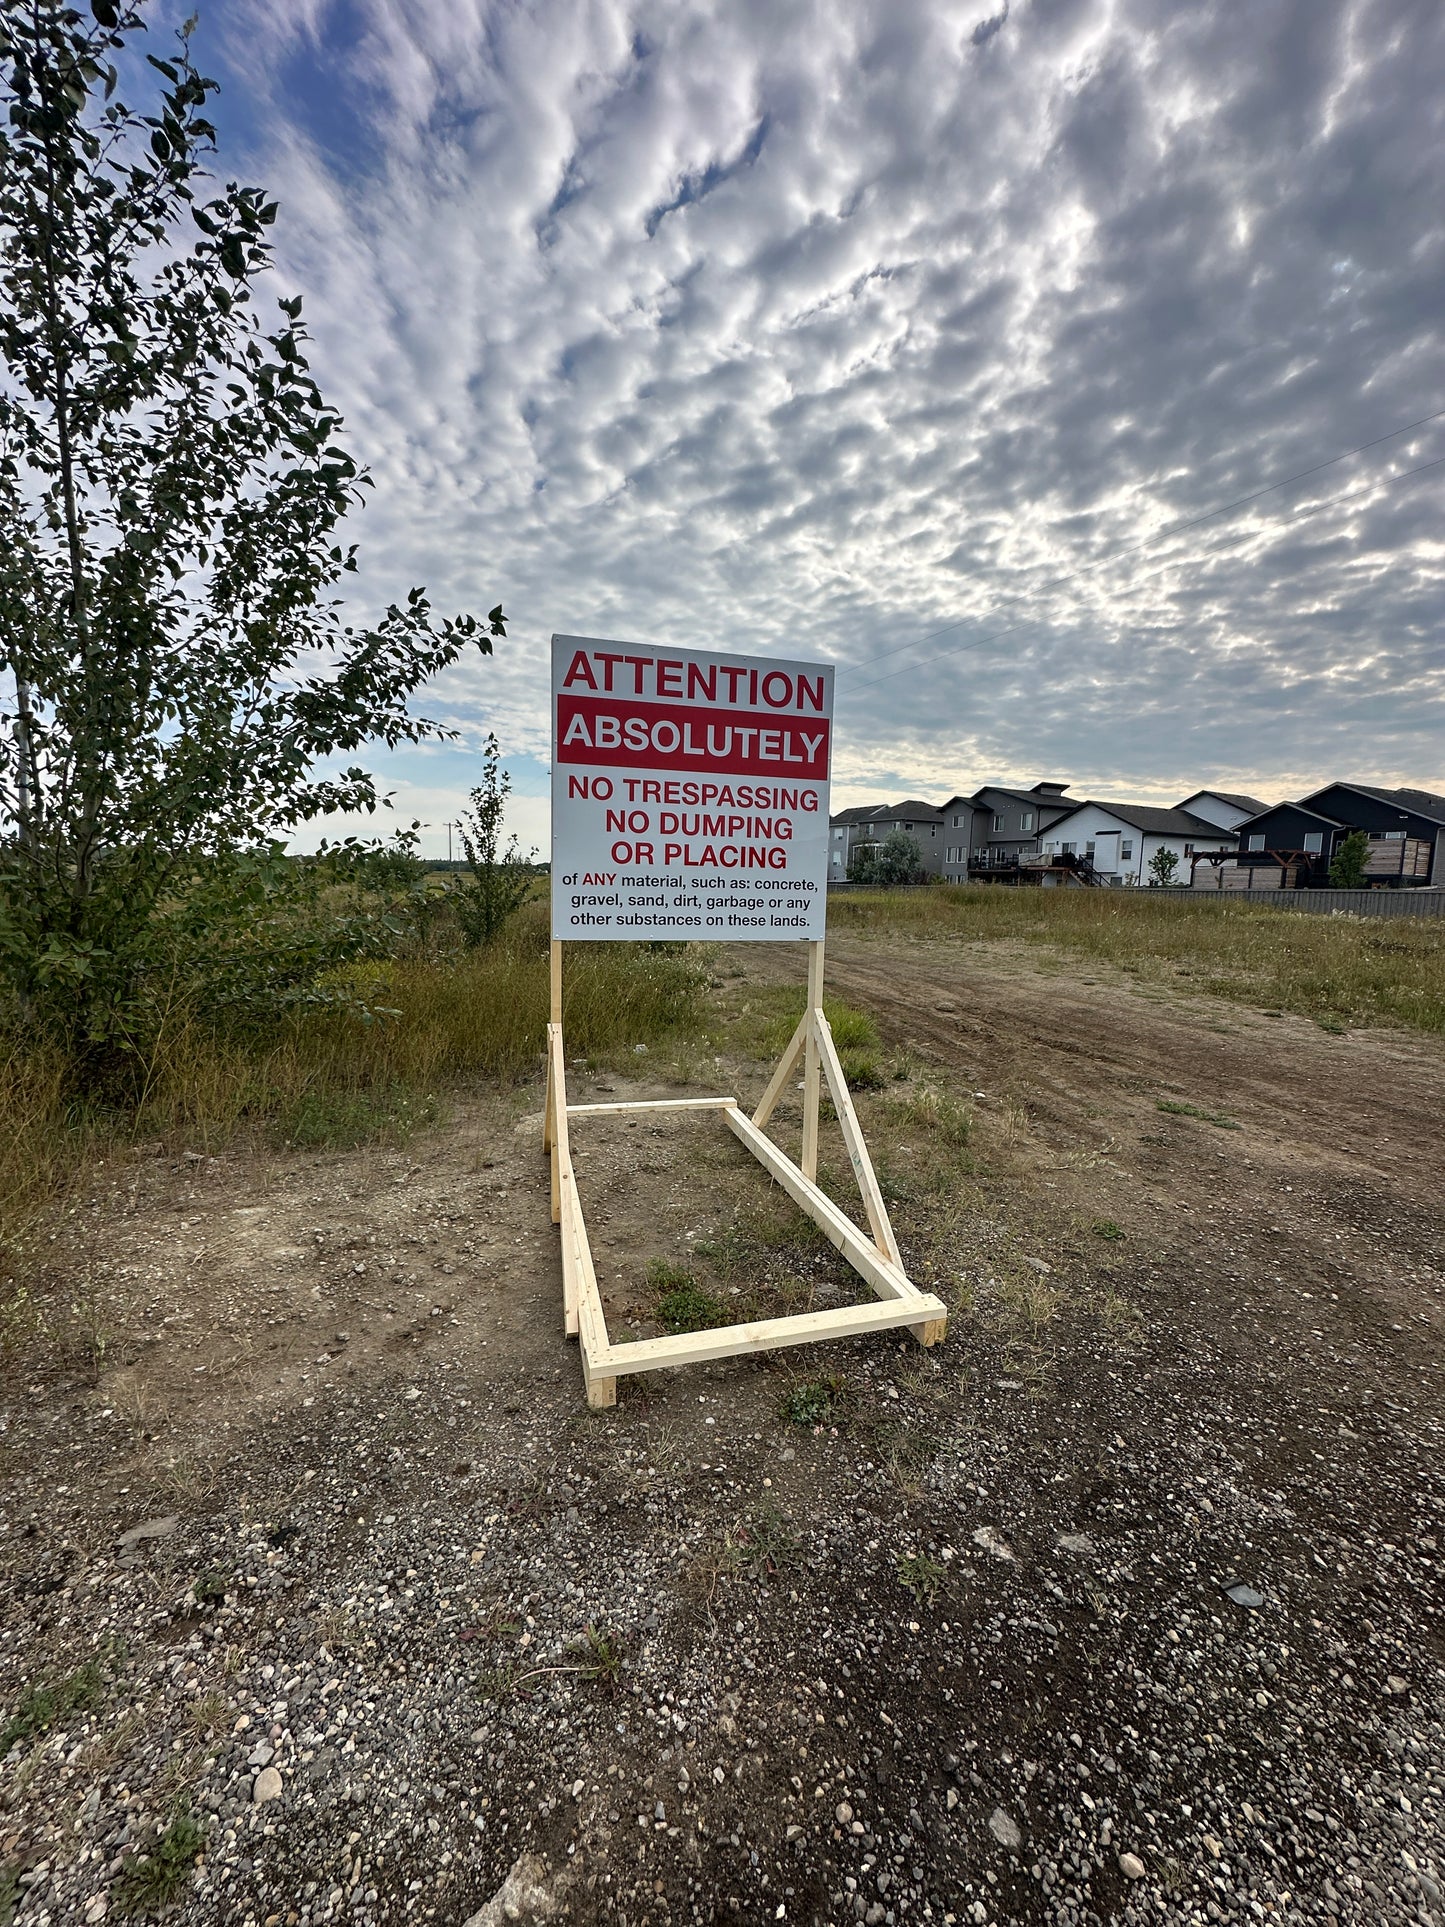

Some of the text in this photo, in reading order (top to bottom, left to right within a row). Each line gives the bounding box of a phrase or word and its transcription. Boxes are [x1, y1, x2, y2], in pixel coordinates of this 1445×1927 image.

[562, 650, 825, 712] ATTENTION
[562, 713, 825, 763] ABSOLUTELY
[568, 775, 819, 812] NO TRESPASSING
[606, 809, 793, 840] NO DUMPING
[611, 841, 787, 870] OR PLACING
[562, 872, 818, 893] of ANY material, such as: concrete,
[570, 894, 811, 911] gravel, sand, dirt, garbage or any
[570, 913, 810, 927] other substances on these lands.
